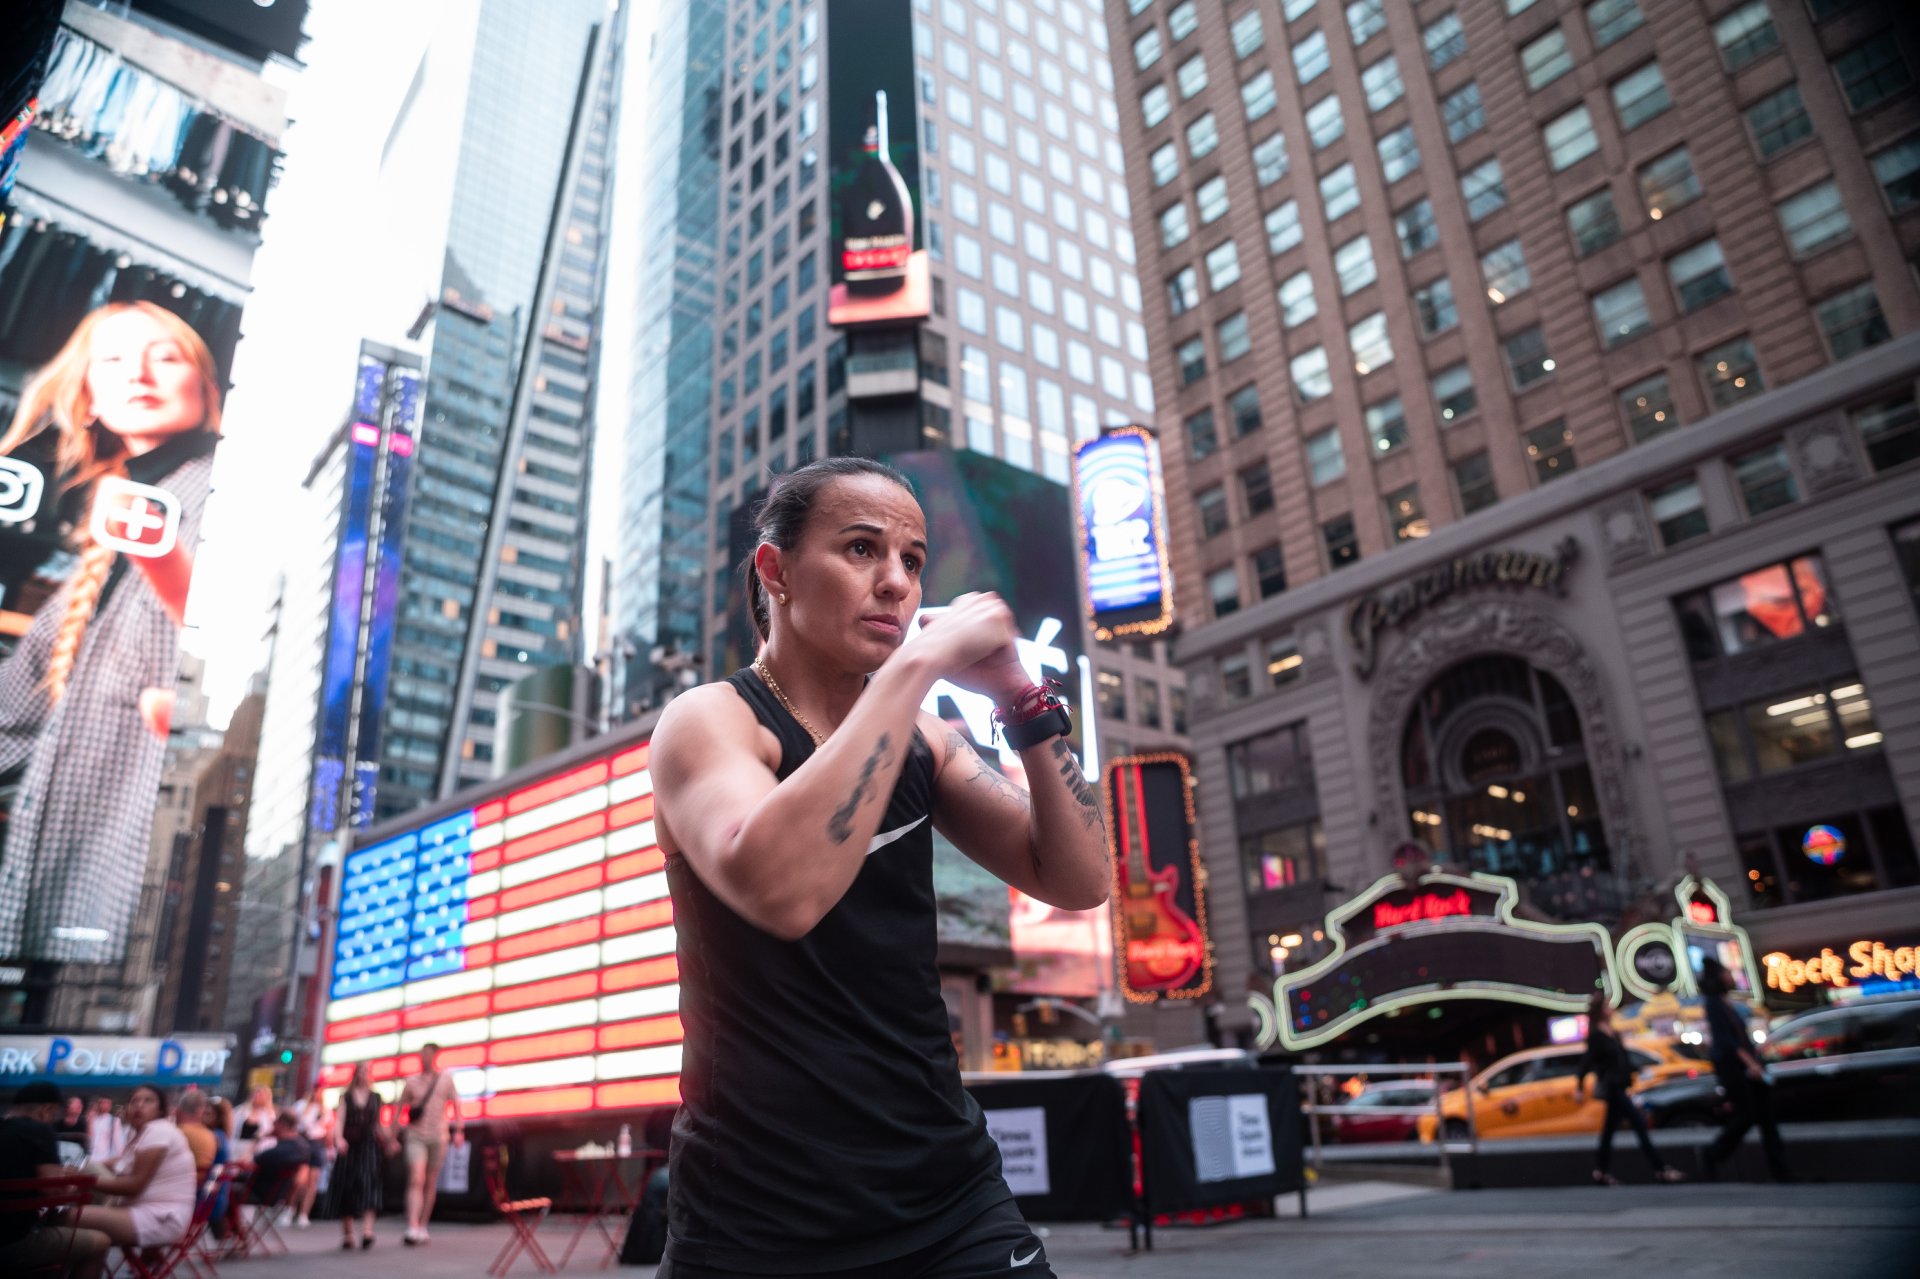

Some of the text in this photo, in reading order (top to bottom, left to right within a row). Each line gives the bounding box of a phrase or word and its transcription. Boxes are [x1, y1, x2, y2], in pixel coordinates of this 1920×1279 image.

[1762, 948, 1849, 993] Rock
[47, 1038, 146, 1075] POLICE
[157, 1040, 231, 1075] DEPT
